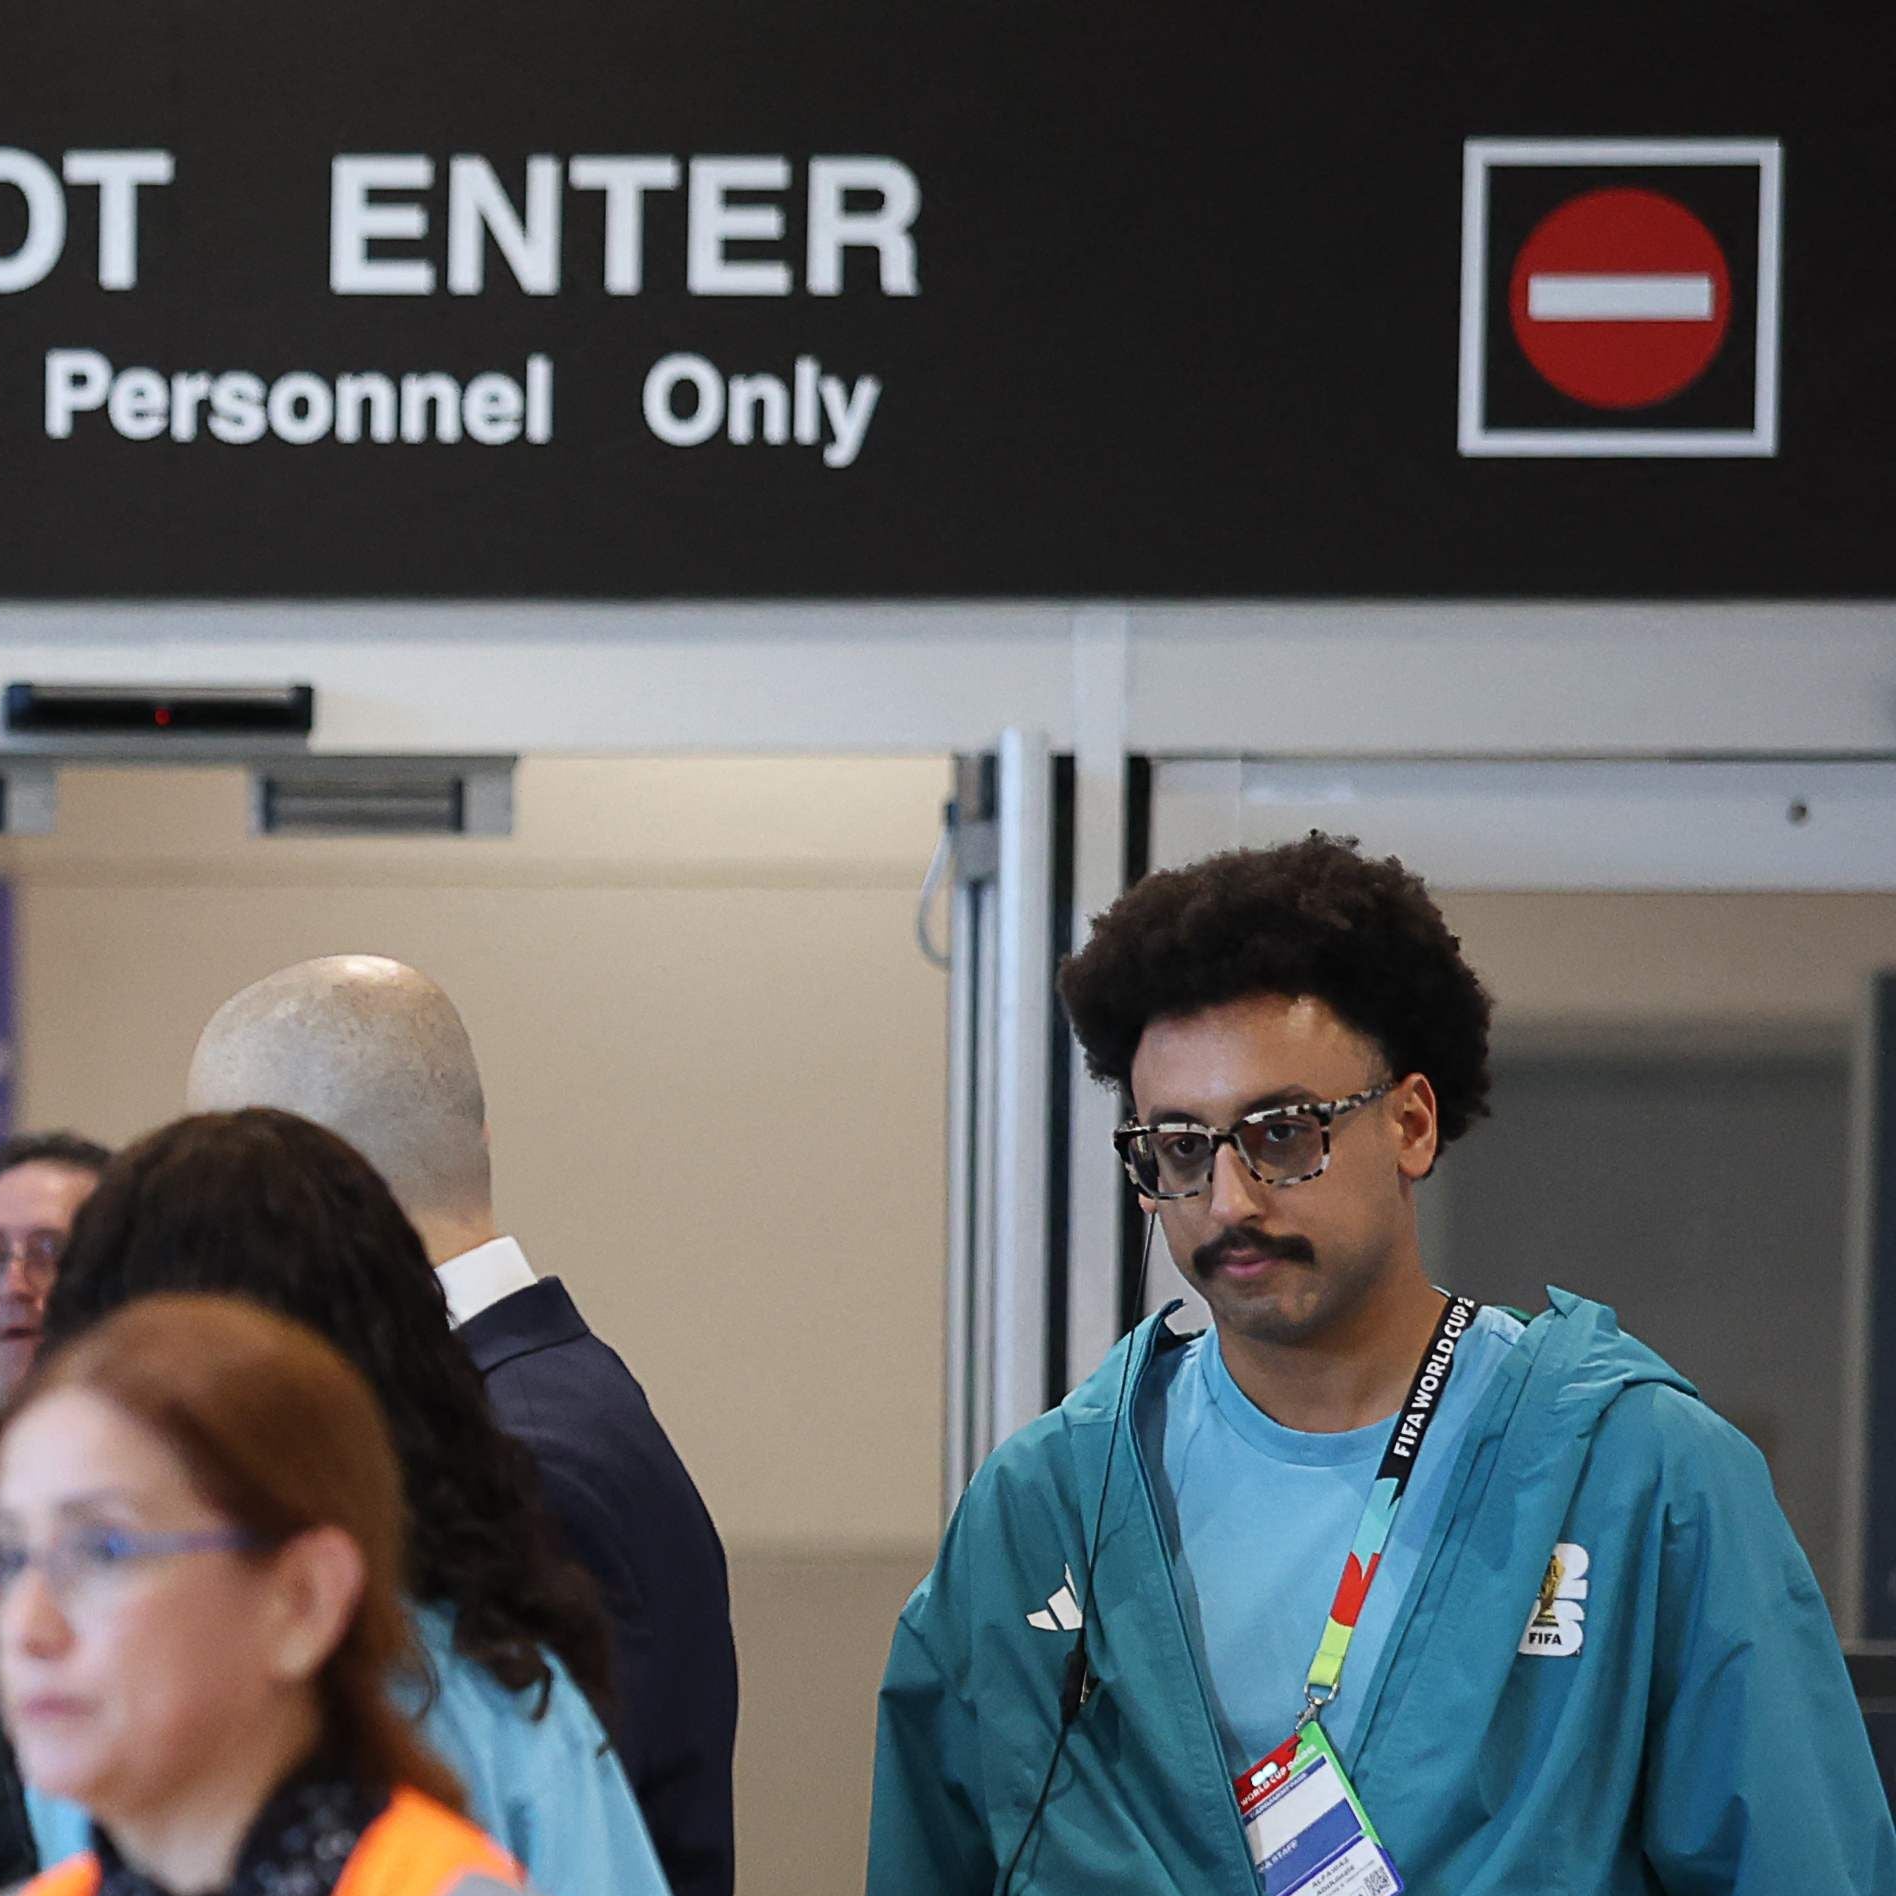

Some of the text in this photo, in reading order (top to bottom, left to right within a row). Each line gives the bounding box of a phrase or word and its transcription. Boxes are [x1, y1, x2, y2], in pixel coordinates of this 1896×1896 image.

[330, 156, 918, 295] ENTER
[46, 350, 551, 444] Personnel
[644, 355, 878, 466] Only
[1394, 1412, 1426, 1458] FIFA
[1411, 1338, 1455, 1409] WORLD
[1444, 1305, 1471, 1338] CUP
[1528, 1632, 1562, 1645] FIFA
